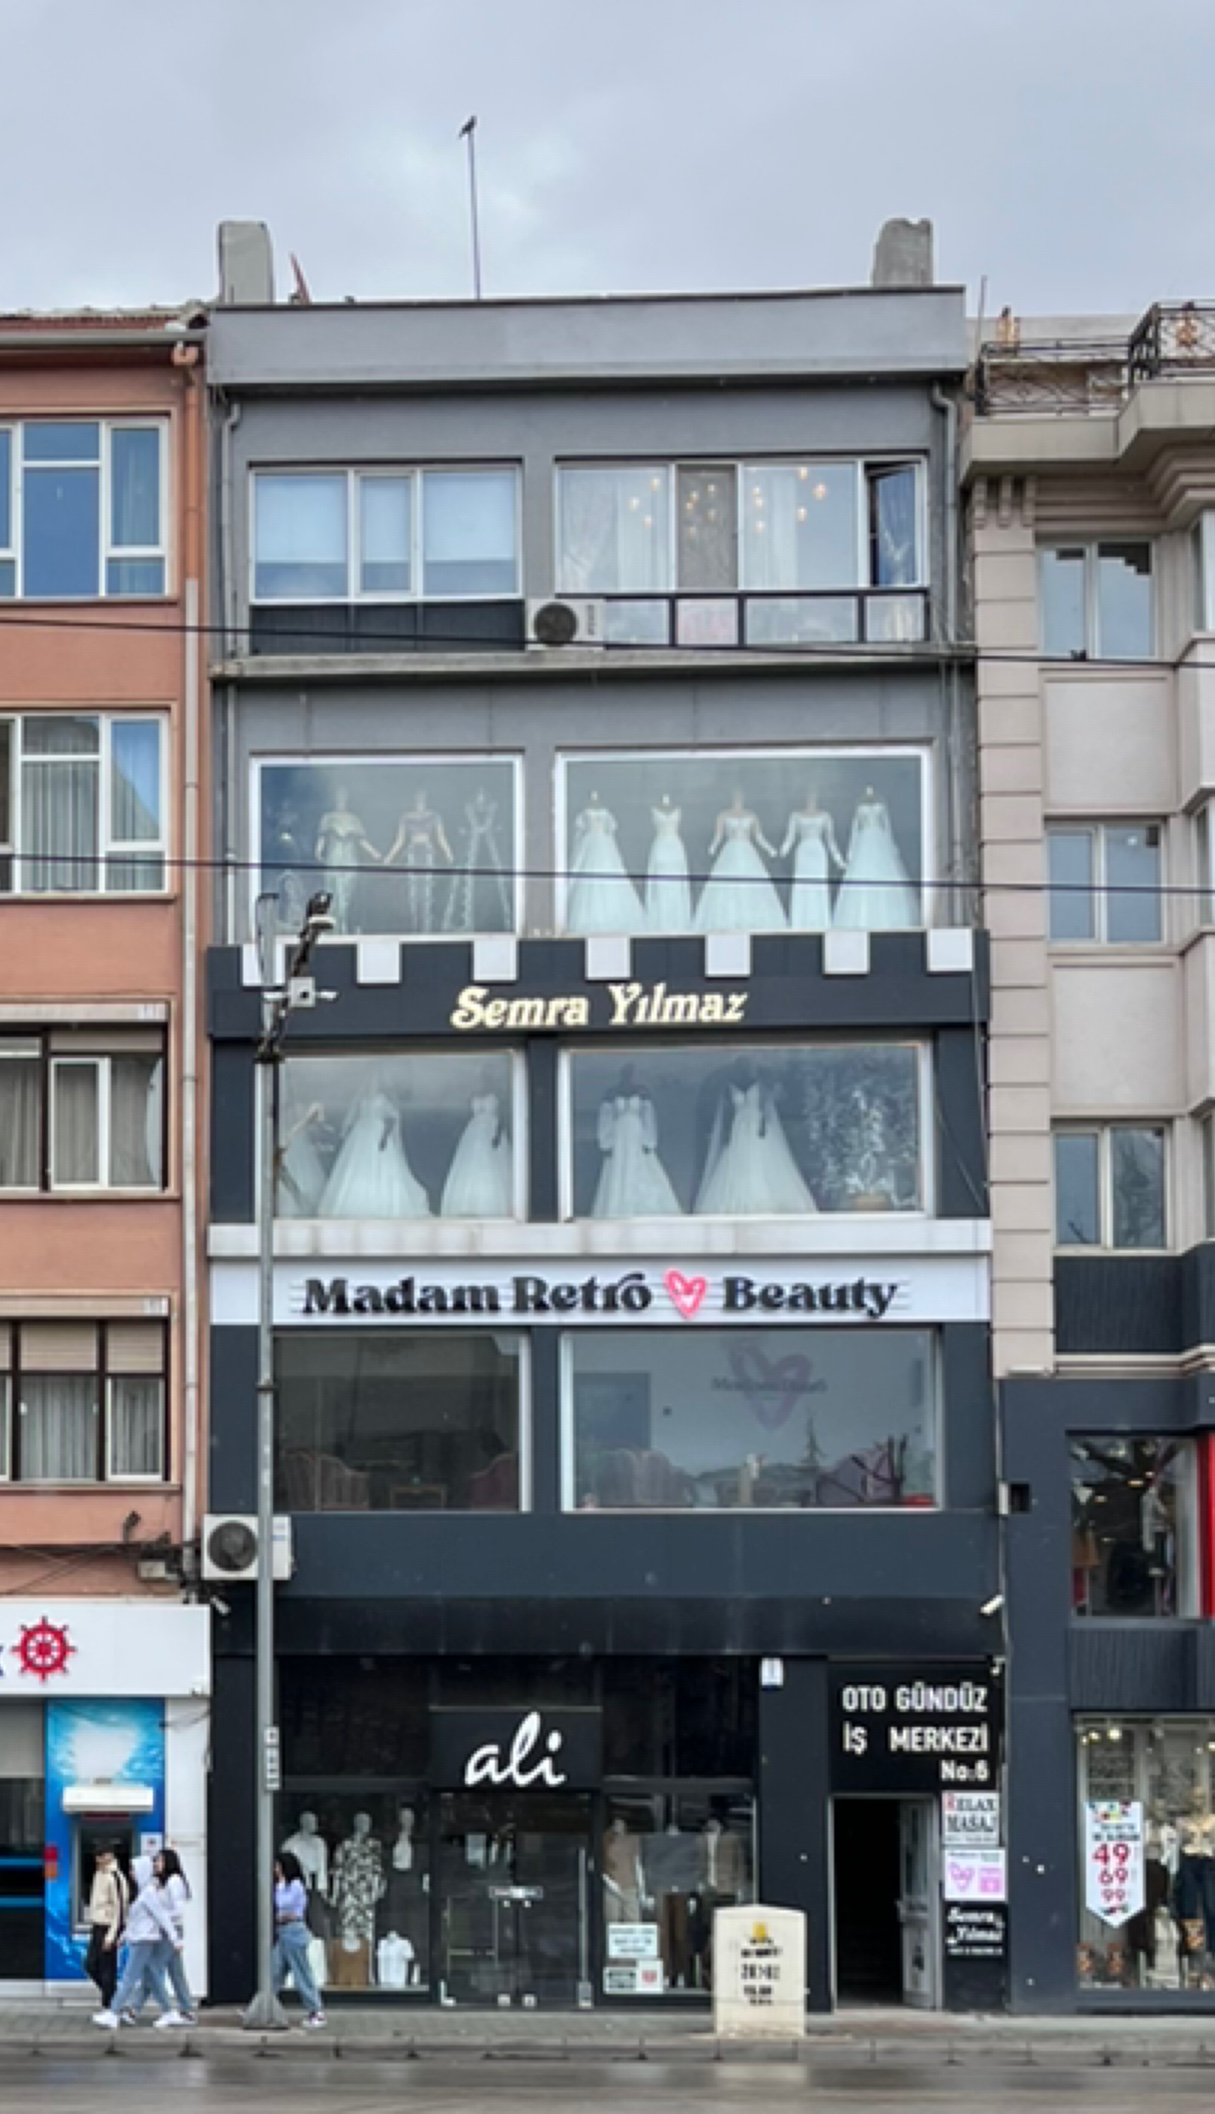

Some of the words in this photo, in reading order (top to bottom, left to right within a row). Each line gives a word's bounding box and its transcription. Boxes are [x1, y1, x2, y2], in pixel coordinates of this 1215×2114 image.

[451, 986, 589, 1028] Semra
[608, 982, 749, 1026] Yılmaz
[303, 1276, 501, 1314] Madam
[723, 1277, 898, 1319] Beauty
[842, 1685, 886, 1712] OTO
[896, 1681, 988, 1712] GÜNDÜZ
[464, 1711, 567, 1787] ali
[843, 1720, 868, 1755] İŞ
[890, 1722, 988, 1751] MERKEZİ
[1093, 1843, 1129, 1866] 49
[1099, 1868, 1128, 1885] 69
[1101, 1888, 1126, 1902] 99
